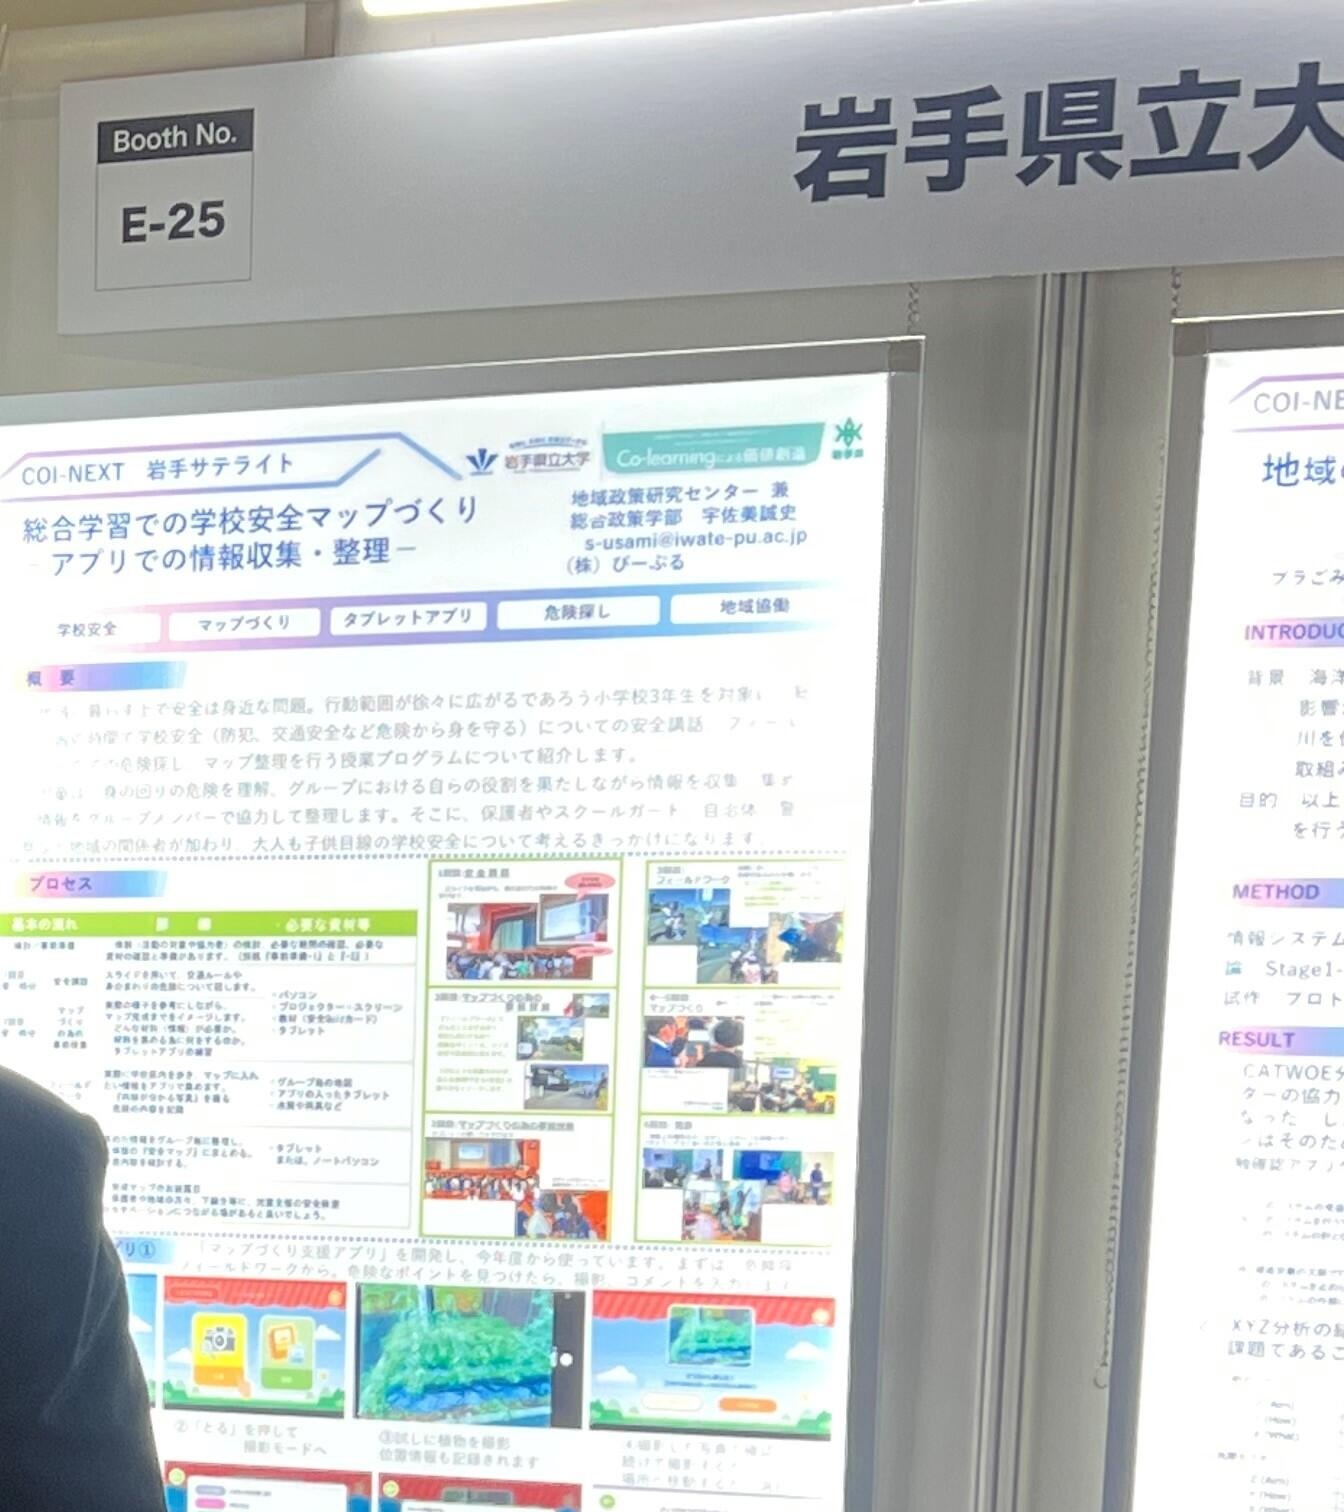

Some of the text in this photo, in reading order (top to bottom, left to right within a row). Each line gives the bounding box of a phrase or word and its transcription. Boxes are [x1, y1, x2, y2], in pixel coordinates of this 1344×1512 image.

[113, 121, 238, 154] Booth No.
[792, 60, 1344, 203] 岩手県立大
[120, 200, 227, 246] E-25
[21, 453, 295, 486] COI-NEXT 岩手サテライト
[1261, 452, 1344, 488] 地域
[571, 484, 760, 505] 地域政策研究センター
[21, 494, 480, 545] 総合学習での学校安全マップづくり
[569, 508, 683, 530] 総合政策学部
[584, 530, 809, 552] s-usami@iwate-pu.ac.jp
[342, 606, 473, 628] タブレットアプリ
[543, 603, 612, 622] 危険探し
[719, 598, 791, 616] 地域協働
[56, 620, 118, 639] 学校安全
[197, 613, 291, 632] マップづくり
[28, 876, 93, 892] プロセス
[1232, 881, 1321, 902] METHOD
[1218, 1030, 1296, 1048] RESULT
